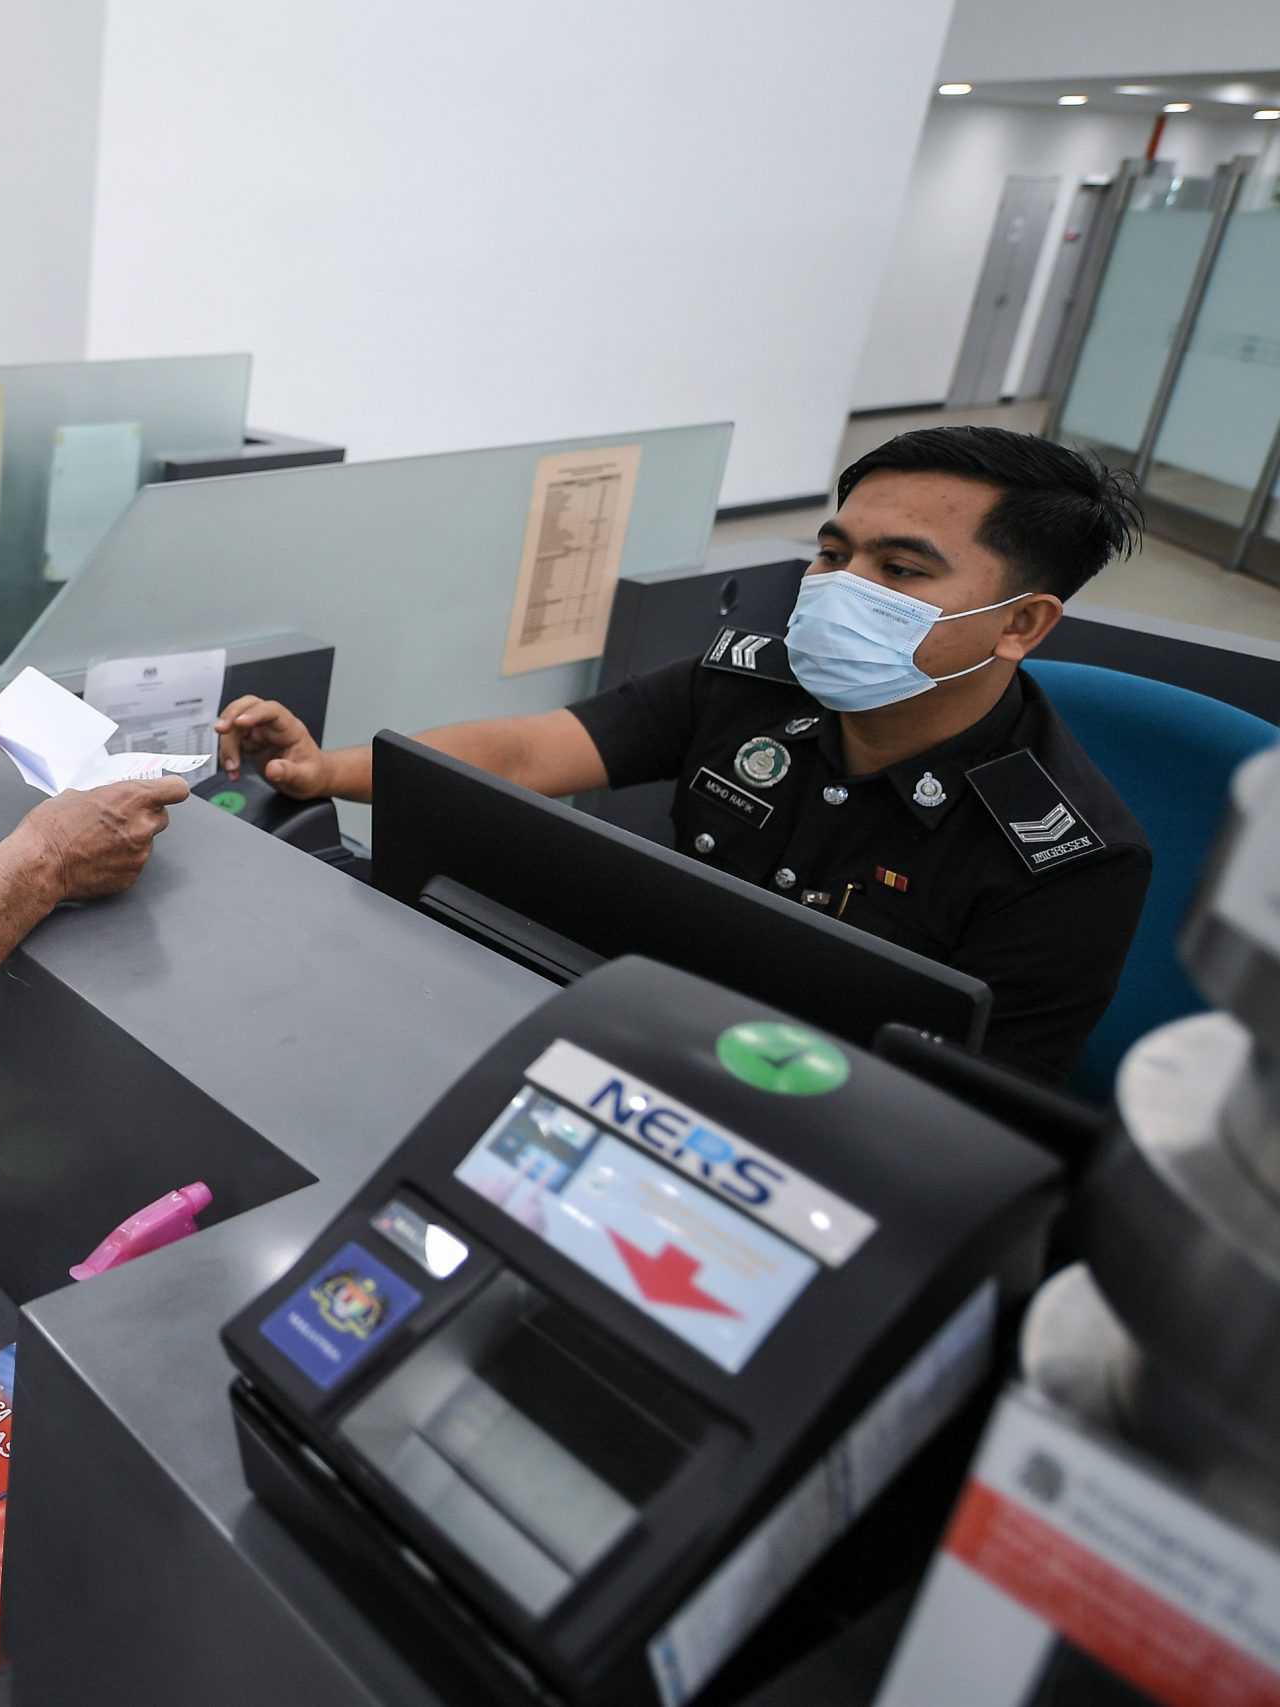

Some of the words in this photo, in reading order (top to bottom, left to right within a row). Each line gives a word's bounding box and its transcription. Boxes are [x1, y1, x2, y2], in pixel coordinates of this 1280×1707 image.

[705, 780, 729, 799] MOHD
[728, 794, 755, 814] RAFIK
[589, 1079, 787, 1206] NERS
